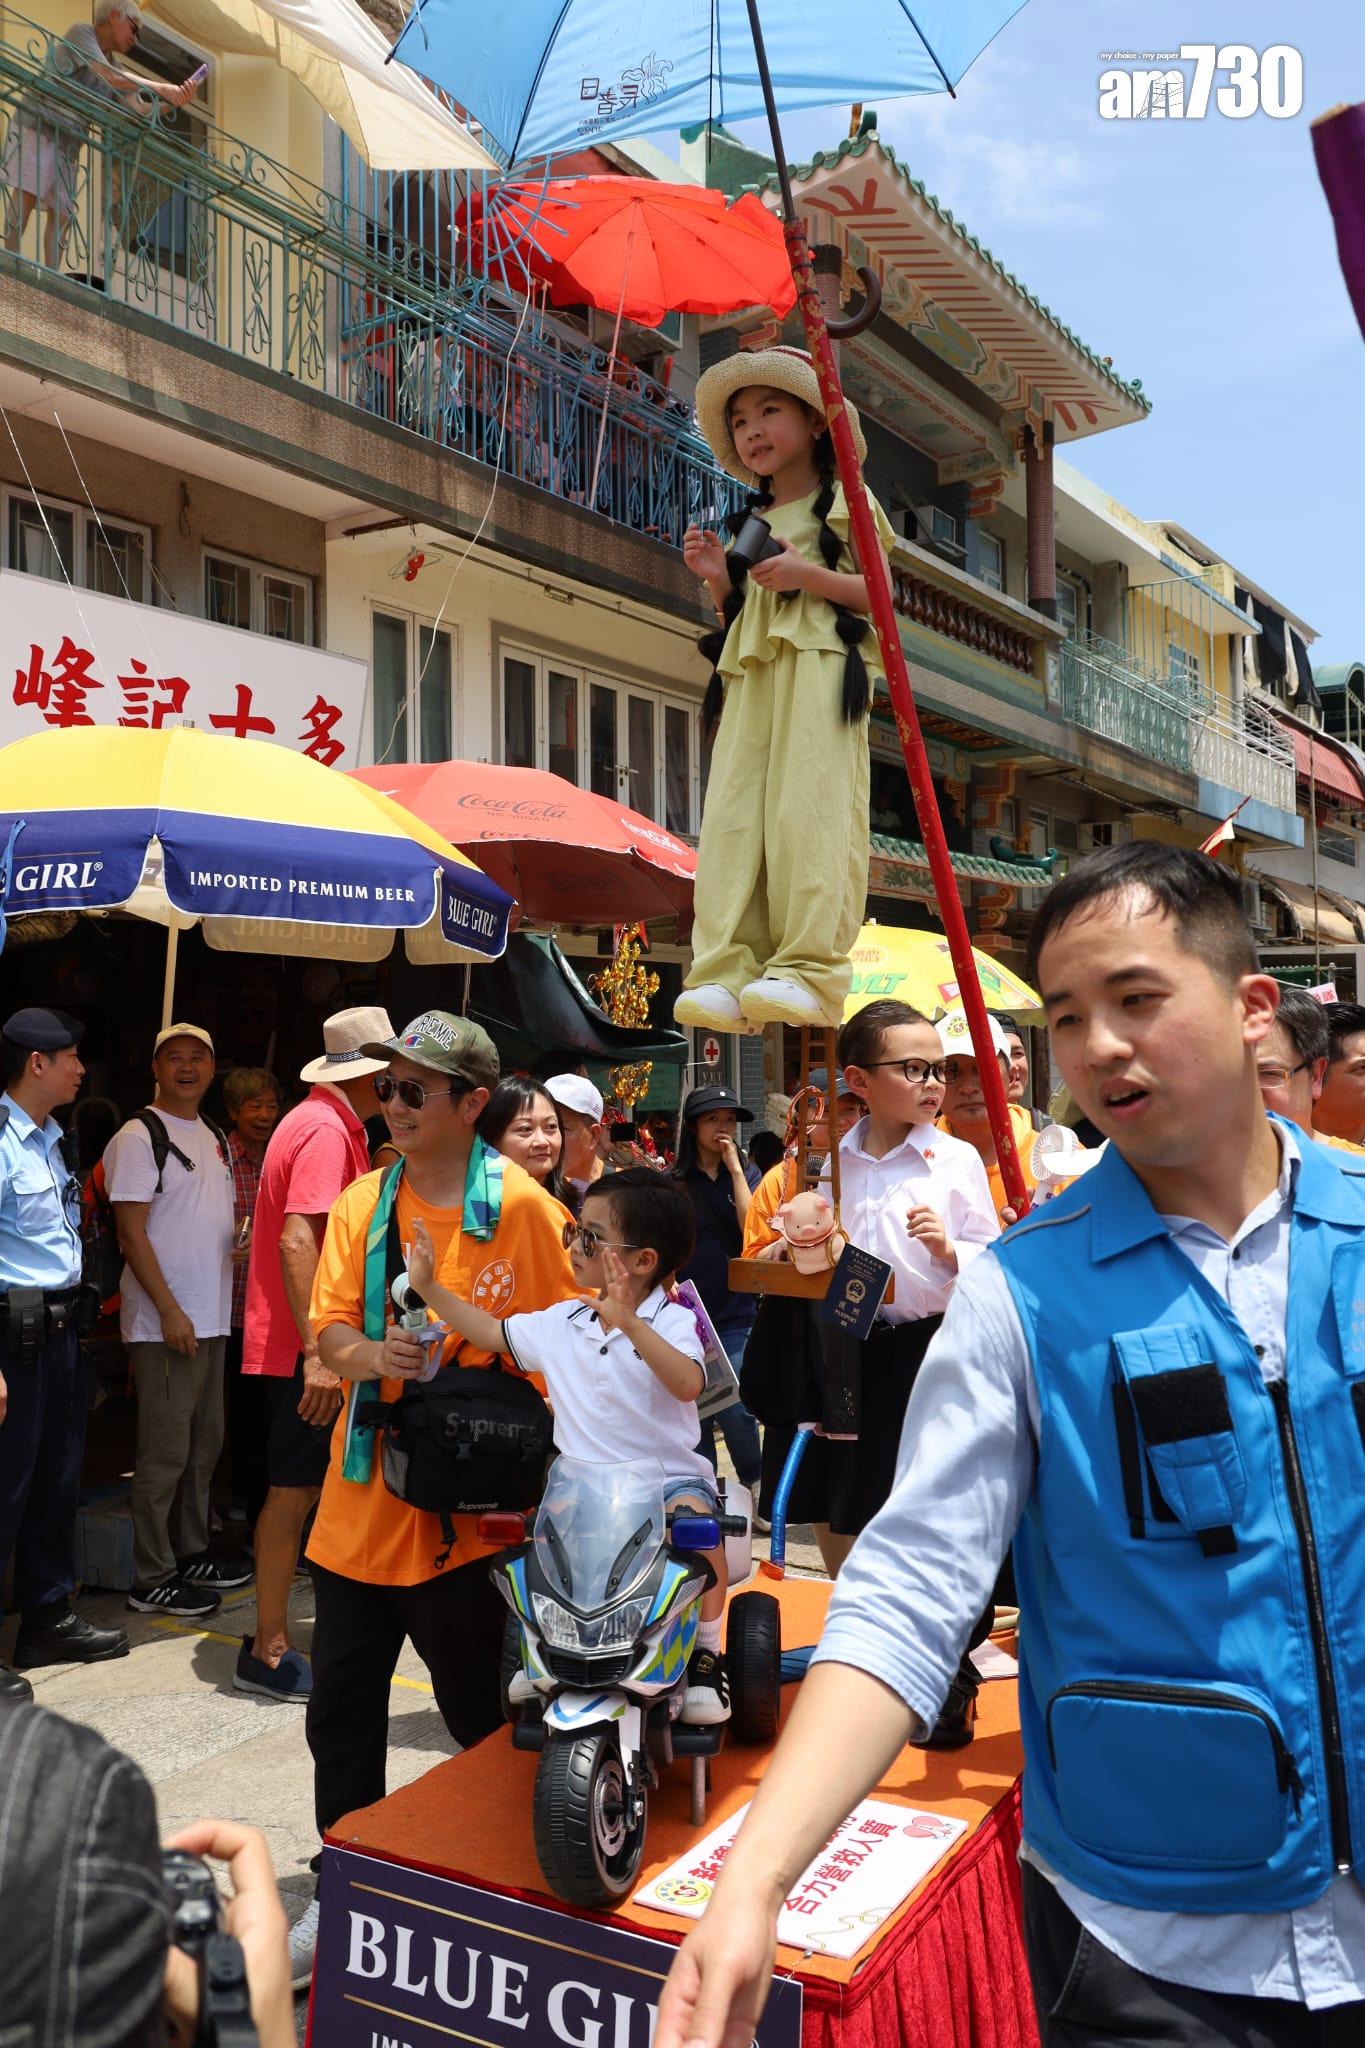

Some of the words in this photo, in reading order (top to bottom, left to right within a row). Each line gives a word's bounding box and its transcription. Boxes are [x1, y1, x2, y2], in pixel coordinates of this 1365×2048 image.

[190, 871, 282, 892] IMPORTED
[289, 880, 369, 900] PREMIUM
[375, 887, 415, 902] BEER
[457, 1501, 499, 1511] Supreme
[783, 1818, 899, 1915] 合力營救人質
[345, 1910, 530, 2030] BLUE
